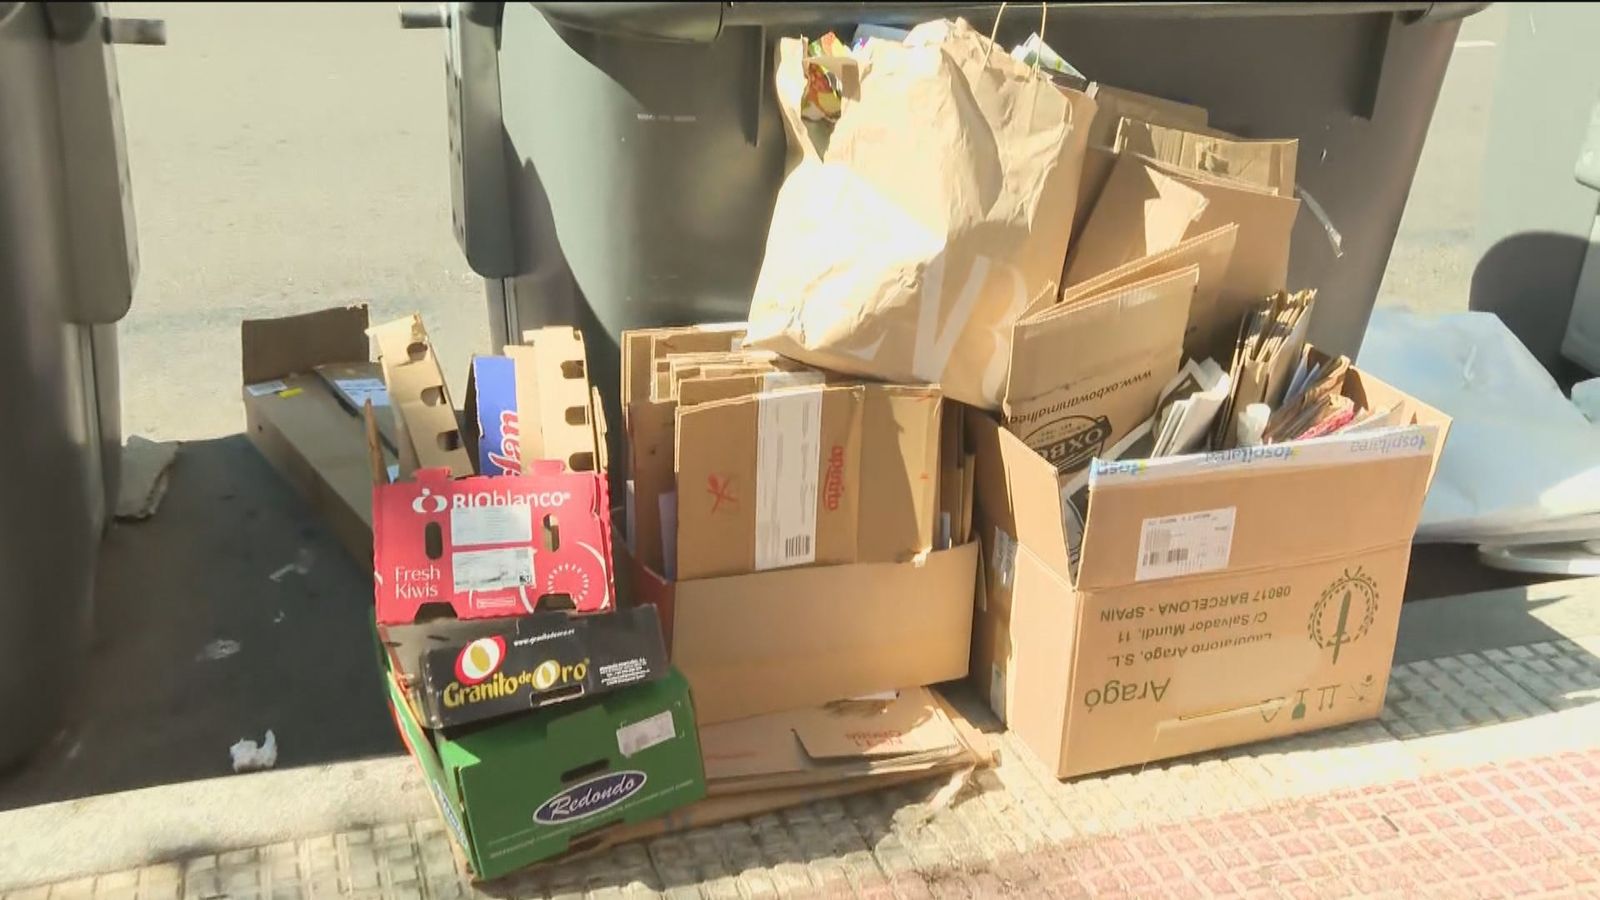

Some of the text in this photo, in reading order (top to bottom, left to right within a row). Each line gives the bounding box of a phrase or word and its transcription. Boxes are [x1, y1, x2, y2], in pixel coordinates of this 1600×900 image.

[1006, 370, 1152, 425] www.oxbowanimalhea
[452, 491, 564, 508] RIOblanco
[395, 564, 440, 581] Fresh
[395, 582, 439, 599] Kiwis
[1252, 585, 1291, 602] 08017
[1158, 591, 1249, 616] BARCELONA
[1100, 606, 1145, 622] SPAIN
[1189, 614, 1250, 631] Salvador
[1118, 631, 1130, 644] 11
[443, 671, 518, 707] Granito
[518, 671, 533, 684] de
[531, 659, 588, 690] Oro
[1084, 678, 1172, 714] Aragó
[549, 775, 635, 820] Redondo
